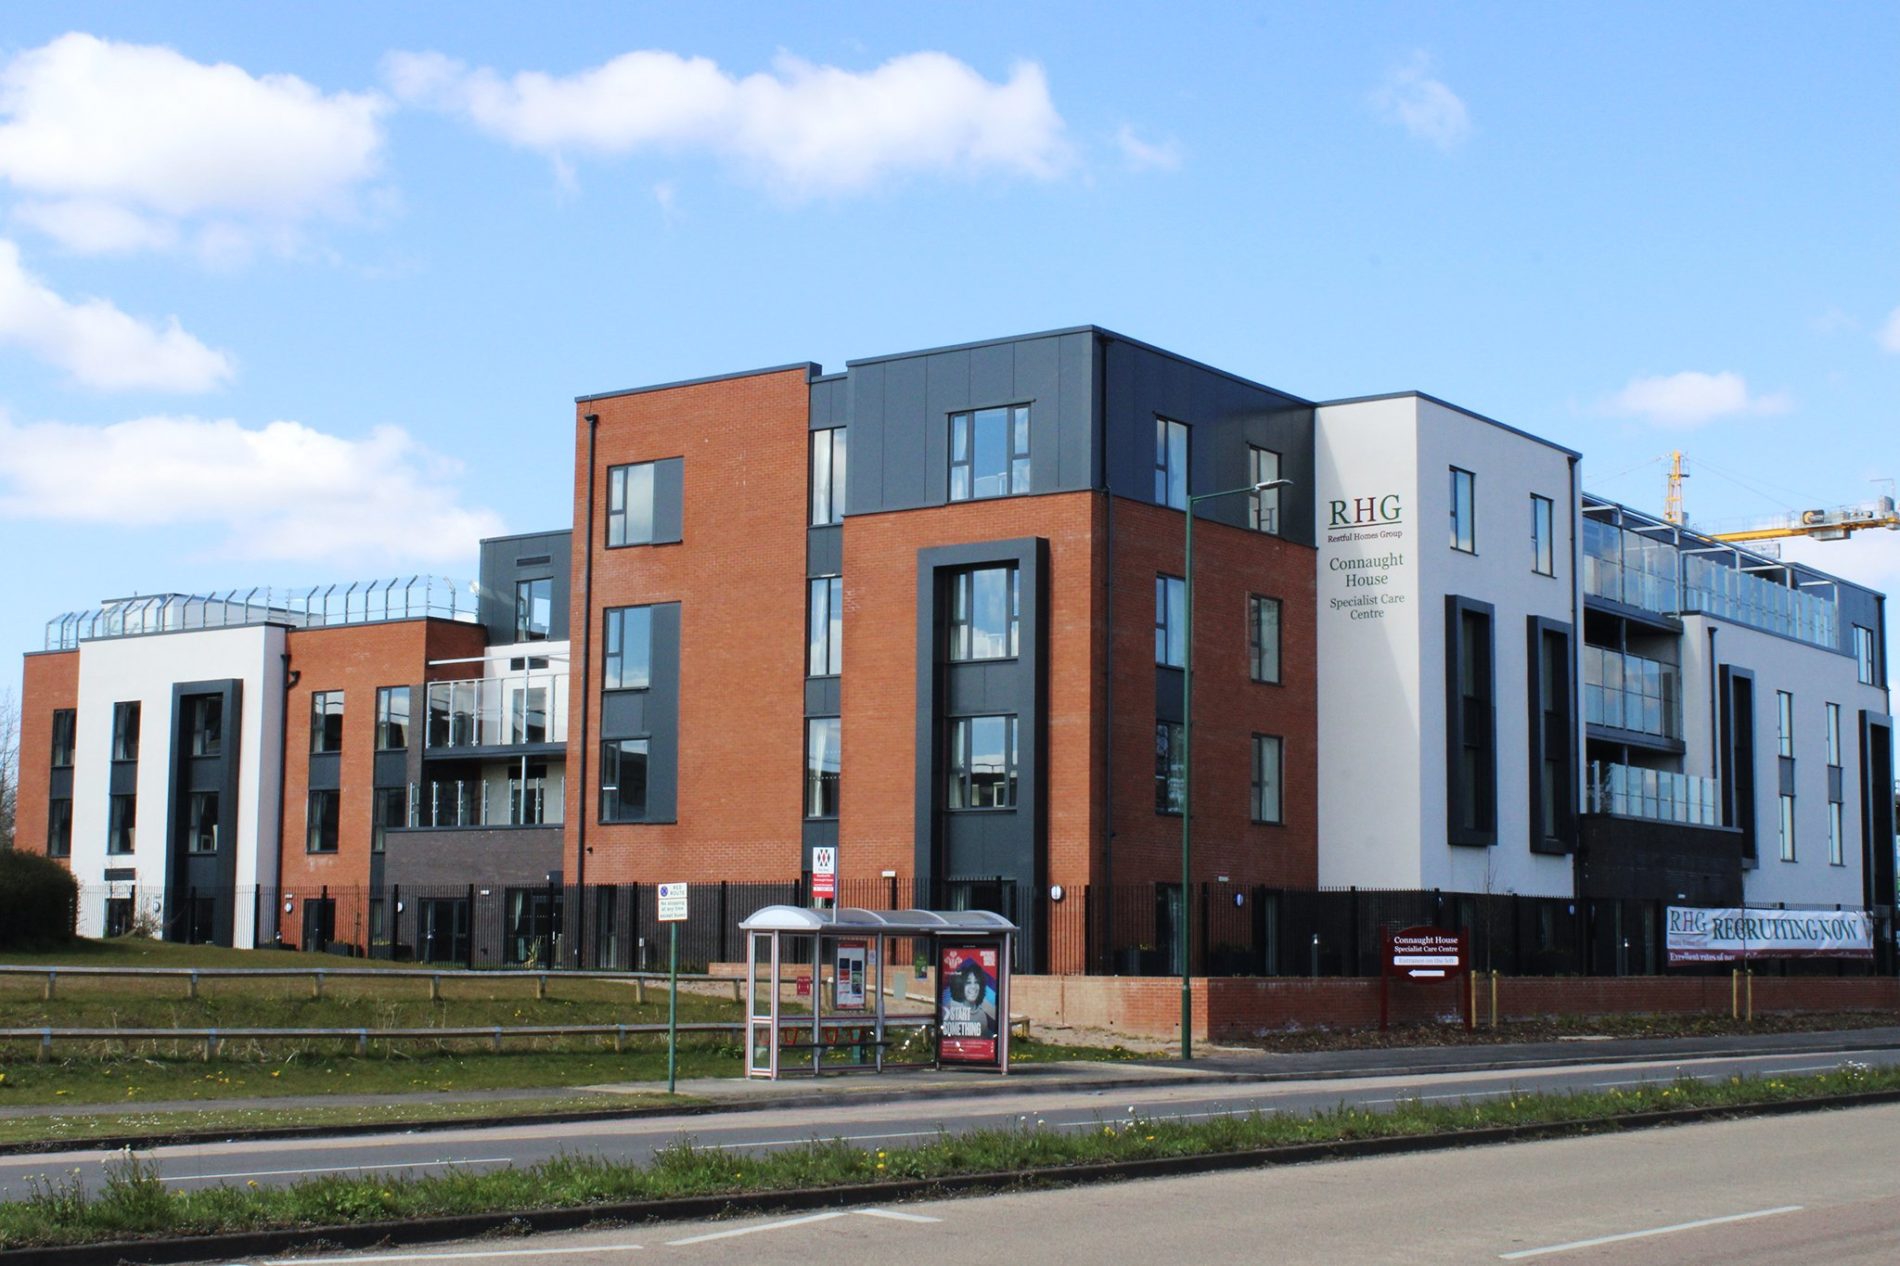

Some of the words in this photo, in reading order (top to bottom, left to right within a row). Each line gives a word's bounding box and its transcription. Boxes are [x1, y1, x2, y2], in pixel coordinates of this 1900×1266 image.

[1328, 494, 1402, 526] RHG
[1327, 531, 1352, 543] Restful
[1354, 532, 1378, 541] Homes
[1380, 530, 1403, 538] Group
[1329, 552, 1404, 571] Connaught
[1346, 574, 1388, 587] House
[1330, 595, 1378, 610] Specialist
[1380, 593, 1405, 605] Care
[1350, 609, 1384, 620] Centre
[1669, 910, 1706, 932] RHG
[1712, 918, 1817, 941] RECRUITING
[1818, 919, 1857, 940] NOW
[1393, 936, 1434, 945] Connaught
[1435, 936, 1458, 944] House
[1394, 946, 1423, 954] Specialist
[950, 1006, 971, 1021] START
[943, 1021, 982, 1036] SOMETHING
